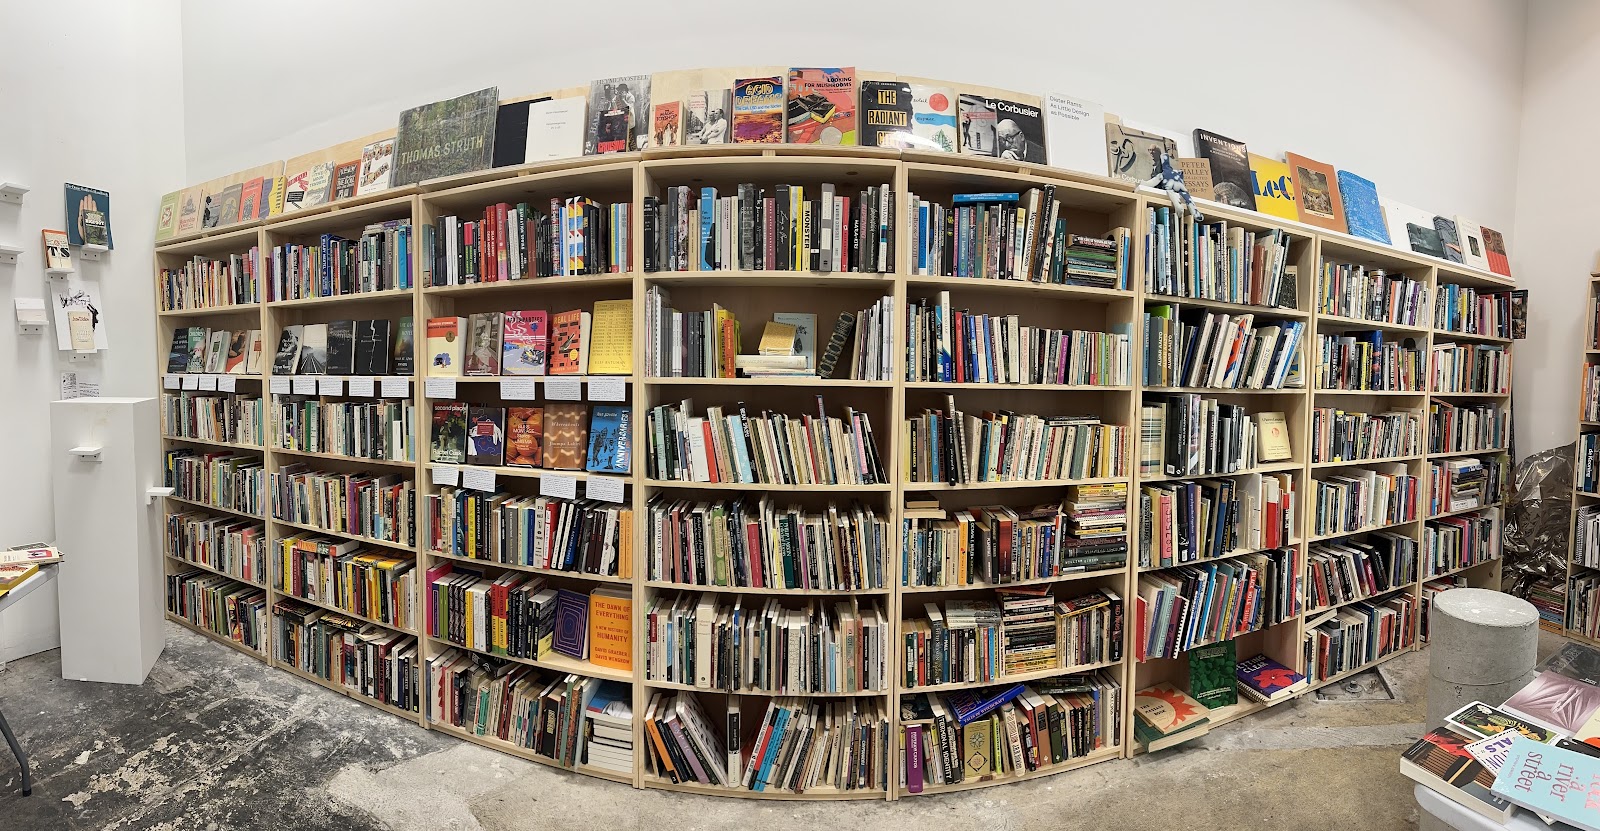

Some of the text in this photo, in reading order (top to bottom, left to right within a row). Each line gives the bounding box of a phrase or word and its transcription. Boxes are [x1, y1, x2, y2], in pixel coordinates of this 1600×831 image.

[746, 84, 773, 96] ACID
[736, 94, 782, 105] DREAMS
[878, 90, 895, 104] THE
[1050, 95, 1066, 104] Dieter
[986, 100, 1039, 118] Le Corbusier
[1057, 104, 1071, 112] Little
[1072, 107, 1090, 117] Design
[869, 111, 906, 125] RADIANT
[1057, 112, 1080, 121] Possible
[401, 135, 483, 165] THOMAS STRUTH
[597, 140, 625, 153] CRUISING
[1200, 134, 1246, 153] INVENTIONS
[554, 313, 579, 324] REAL LIFE
[615, 414, 629, 469] ANNIVERSARIES
[596, 610, 629, 621] EVERYTHING
[597, 632, 628, 642] HUMANITY
[608, 649, 627, 657] GRAEBER
[1244, 662, 1269, 673] CLEAR
[939, 719, 952, 779] TERMINAL IDENTITY
[1484, 737, 1513, 753] ALS
[1514, 751, 1543, 793] street
[1536, 770, 1552, 781] a
[1550, 763, 1574, 802] river
